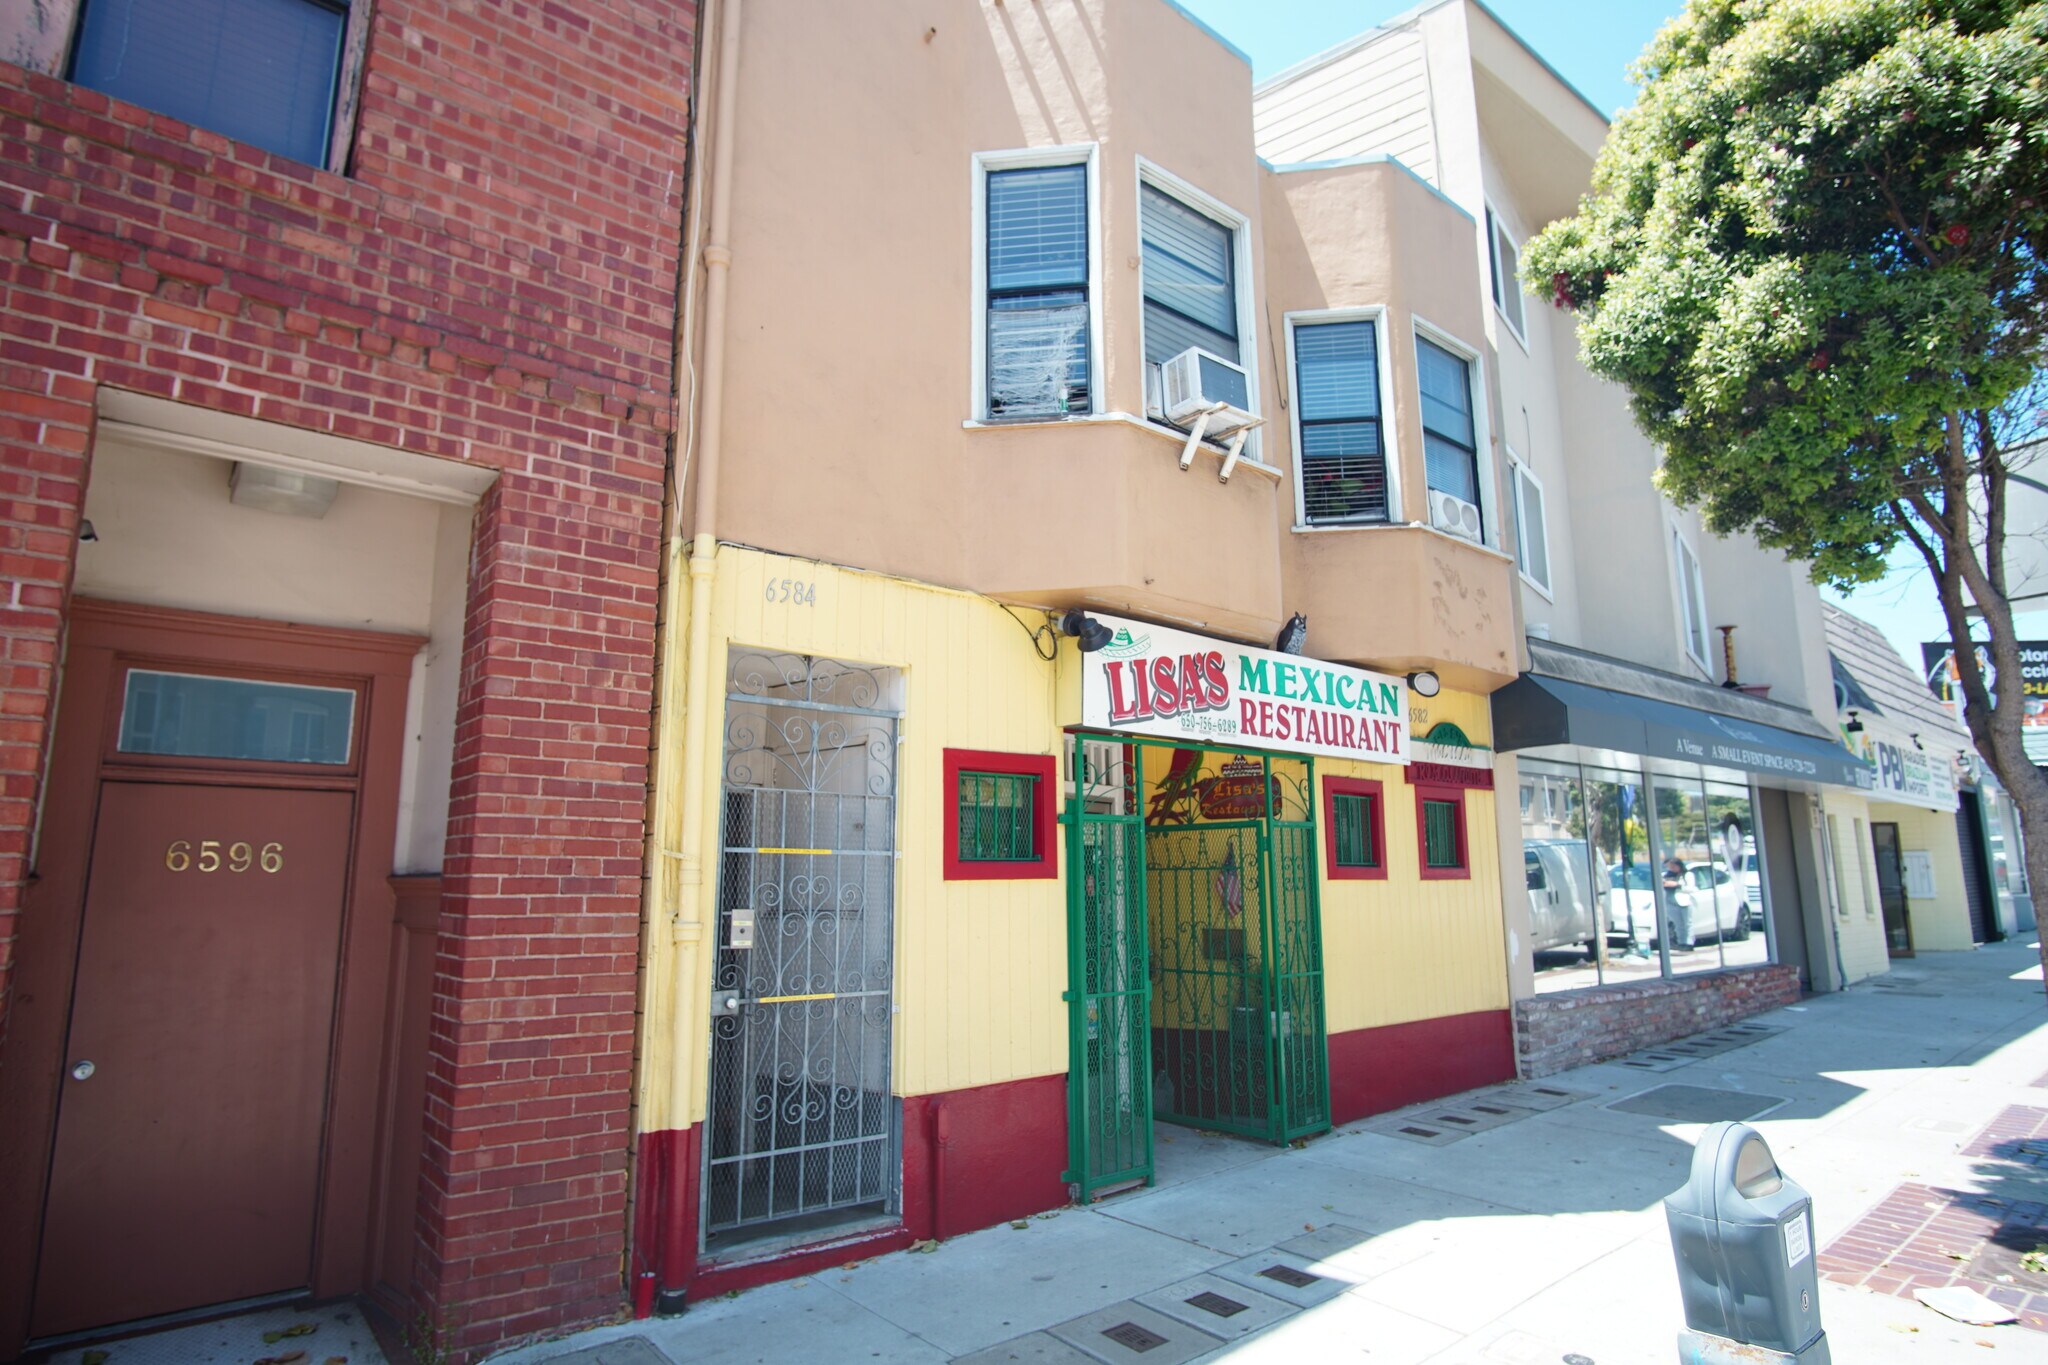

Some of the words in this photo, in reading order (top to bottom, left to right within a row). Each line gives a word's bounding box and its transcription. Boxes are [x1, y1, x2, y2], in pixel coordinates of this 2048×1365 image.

[766, 577, 816, 607] 6584
[1103, 650, 1230, 726] LISA'S
[1238, 655, 1399, 716] MEXICAN
[1180, 712, 1237, 734] 650-756-6289
[1239, 698, 1402, 754] RESTAURANT
[1409, 706, 1428, 723] 6582
[1717, 745, 1741, 762] SMALL
[1741, 750, 1763, 766] EVENT
[1878, 741, 1907, 792] PBI
[1213, 780, 1265, 800] Lisa's
[166, 840, 283, 873] 6596
